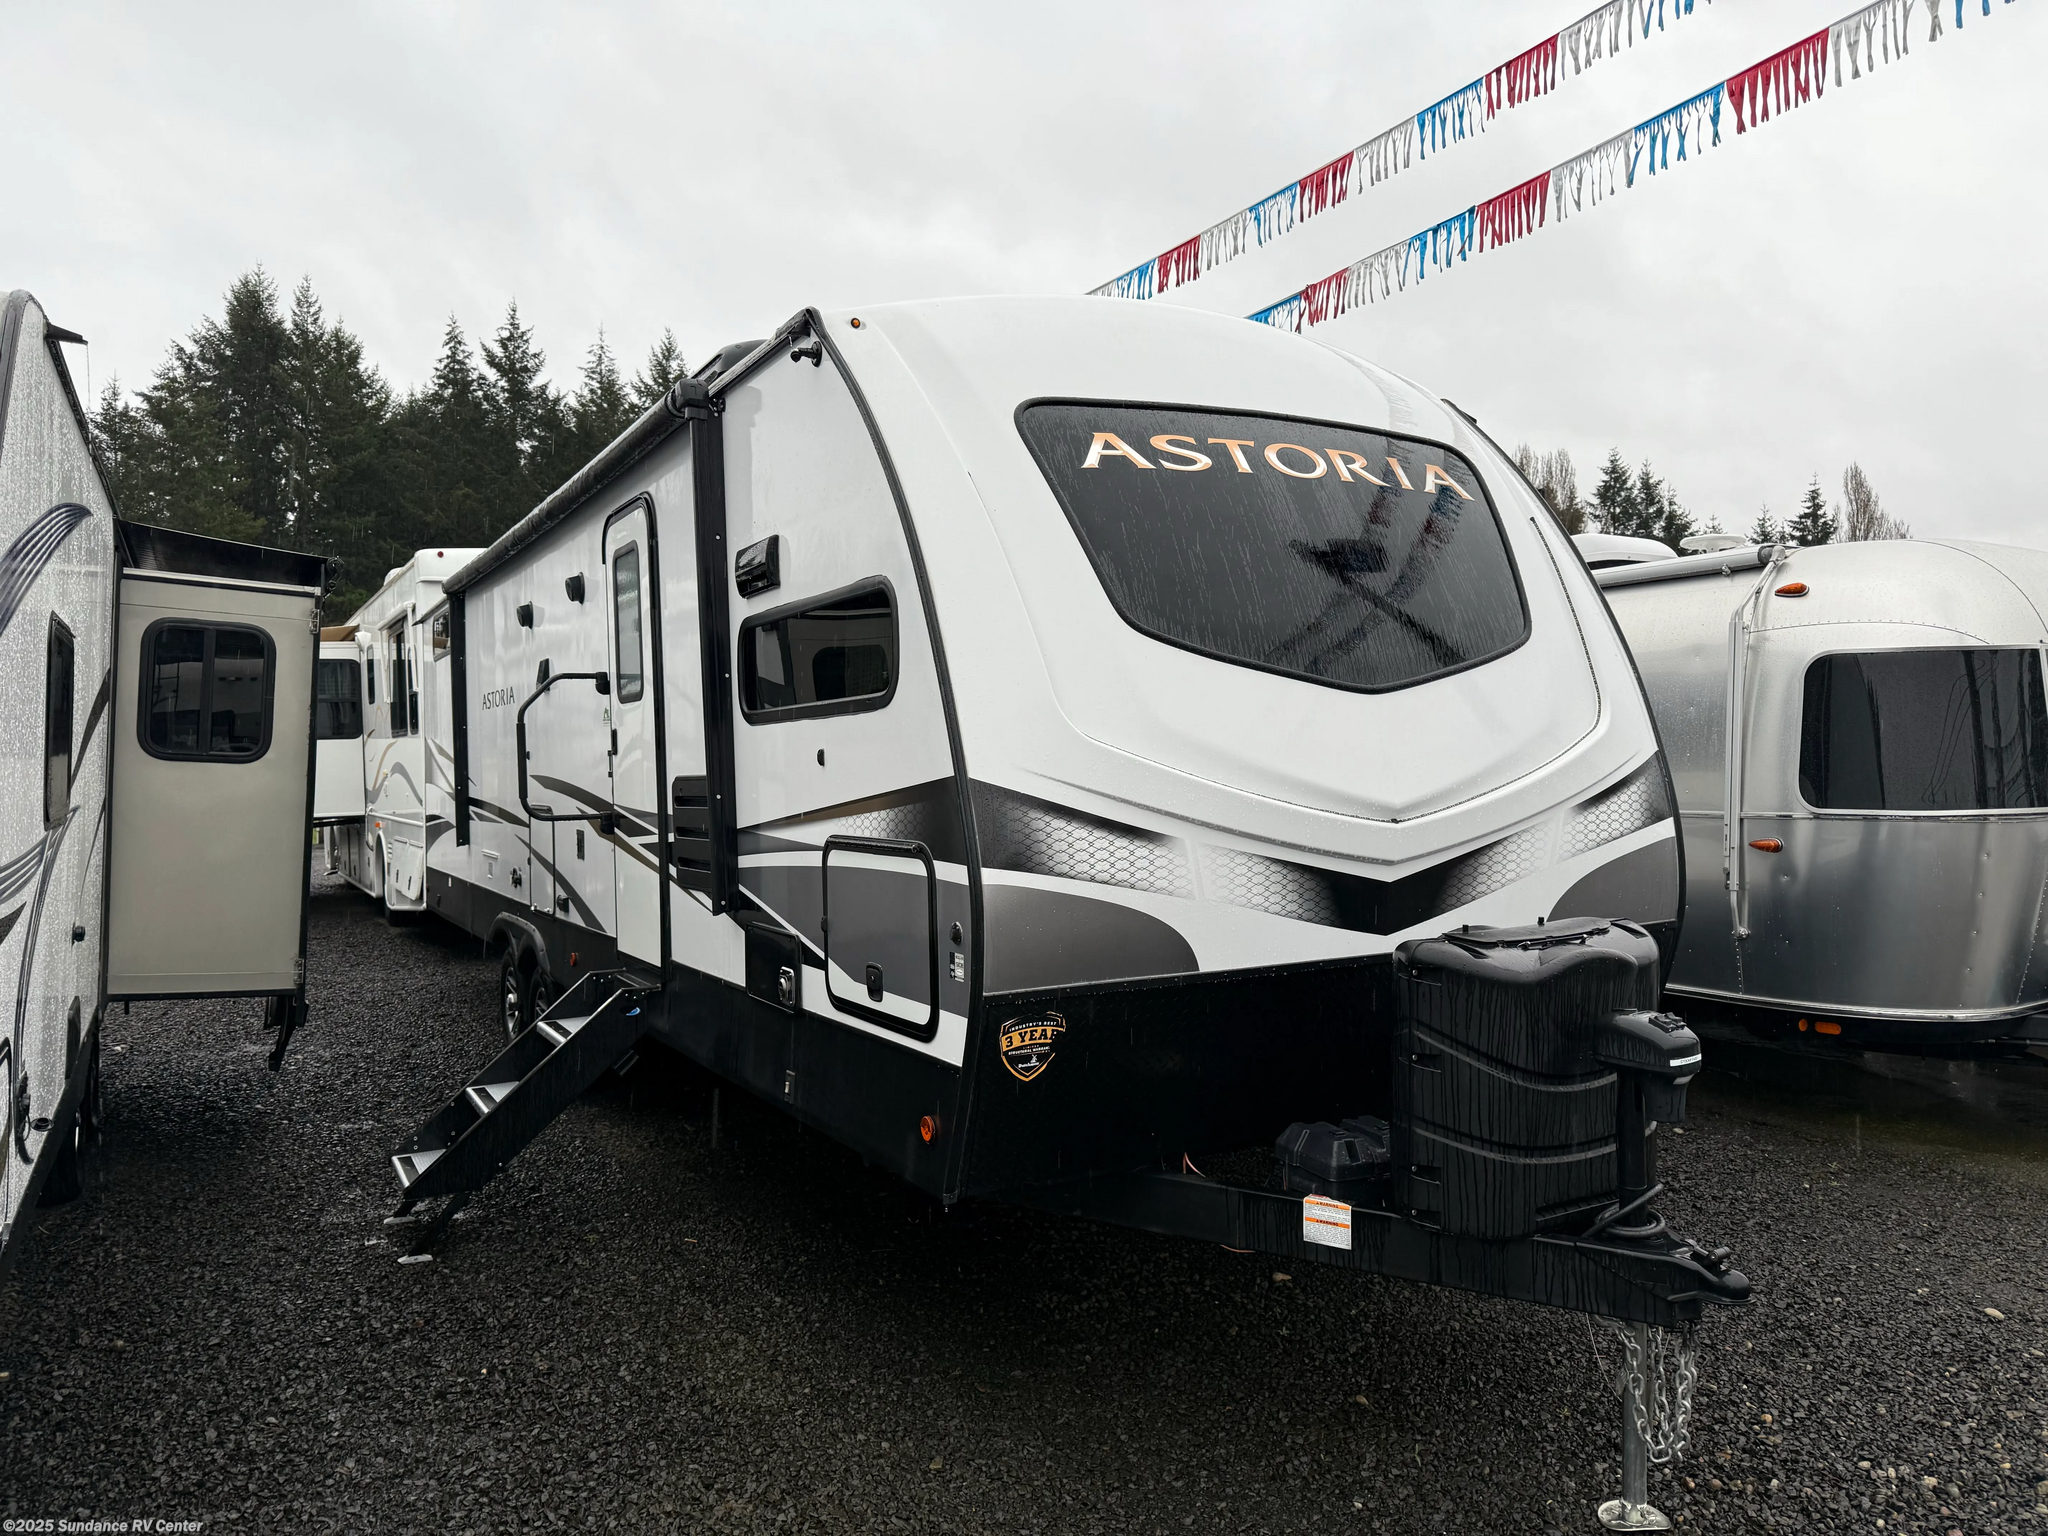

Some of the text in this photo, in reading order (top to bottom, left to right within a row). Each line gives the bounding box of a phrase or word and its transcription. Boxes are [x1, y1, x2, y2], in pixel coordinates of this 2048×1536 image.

[1081, 431, 1476, 501] ASTORIA
[482, 686, 515, 710] ASTORIA
[1009, 1021, 1042, 1032] INDUSTRY'S
[1005, 1035, 1013, 1048] 3
